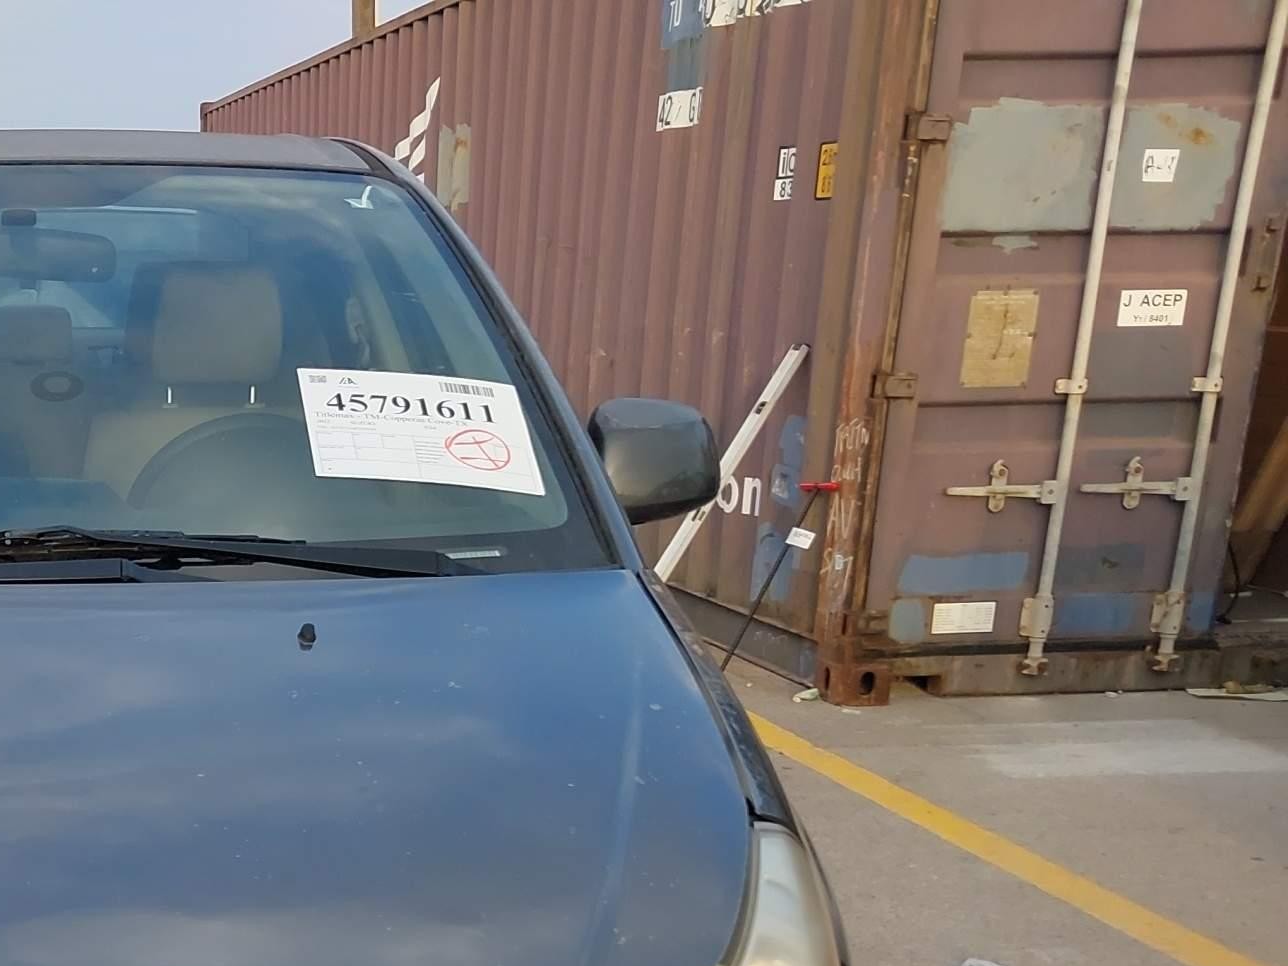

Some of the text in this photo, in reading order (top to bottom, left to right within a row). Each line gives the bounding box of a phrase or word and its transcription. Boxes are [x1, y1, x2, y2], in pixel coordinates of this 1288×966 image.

[1123, 294, 1183, 307] J ACEP
[325, 393, 497, 424] 45791611
